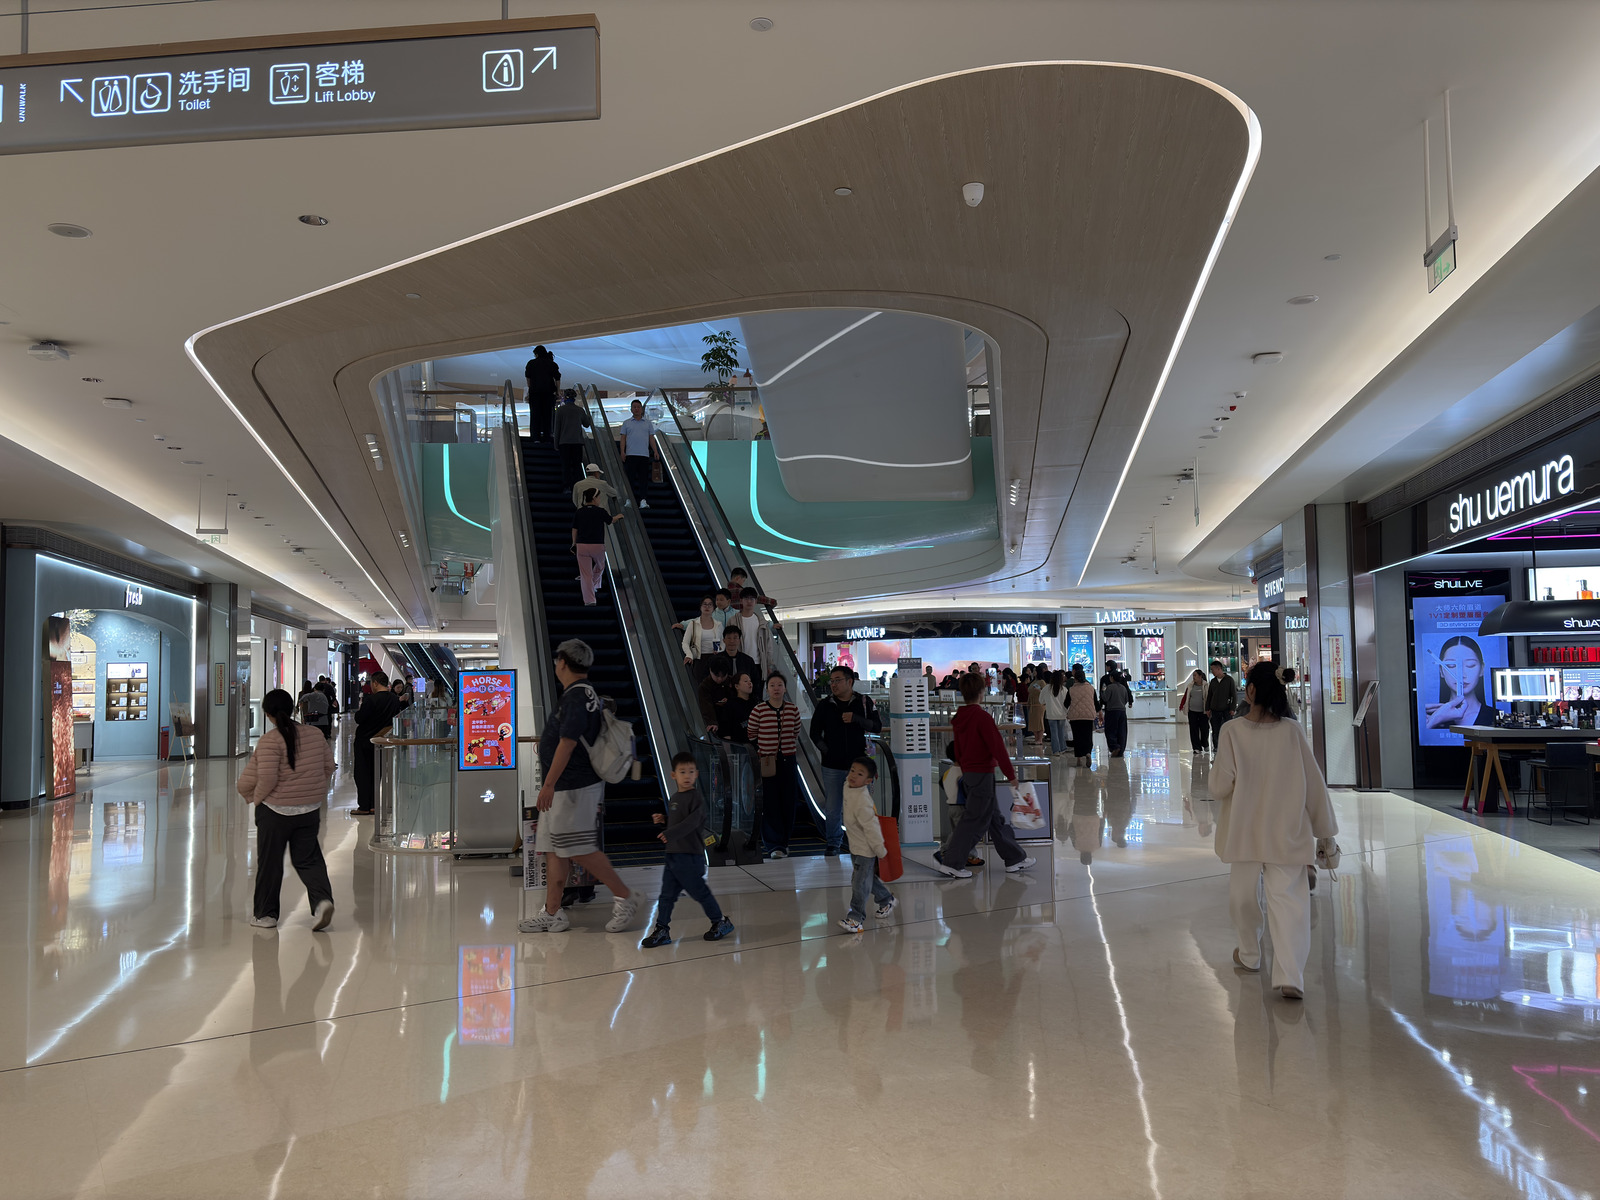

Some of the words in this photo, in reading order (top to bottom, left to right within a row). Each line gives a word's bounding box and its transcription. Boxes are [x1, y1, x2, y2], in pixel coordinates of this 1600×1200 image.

[178, 66, 251, 96] 洗手间
[315, 59, 365, 88] 客梯
[18, 83, 27, 123] UNIWALK
[178, 98, 211, 111] Toilet
[314, 90, 334, 103] Lift
[336, 88, 376, 103] Lobby
[1449, 493, 1482, 533] shu
[1486, 454, 1575, 521] uemura
[124, 584, 143, 608] fresh
[1111, 609, 1137, 623] MER
[846, 626, 879, 640] LANCÔME
[990, 622, 1039, 635] LANCÔME
[471, 676, 503, 687] HORSE
[527, 849, 536, 888] TRANSFORMERS
